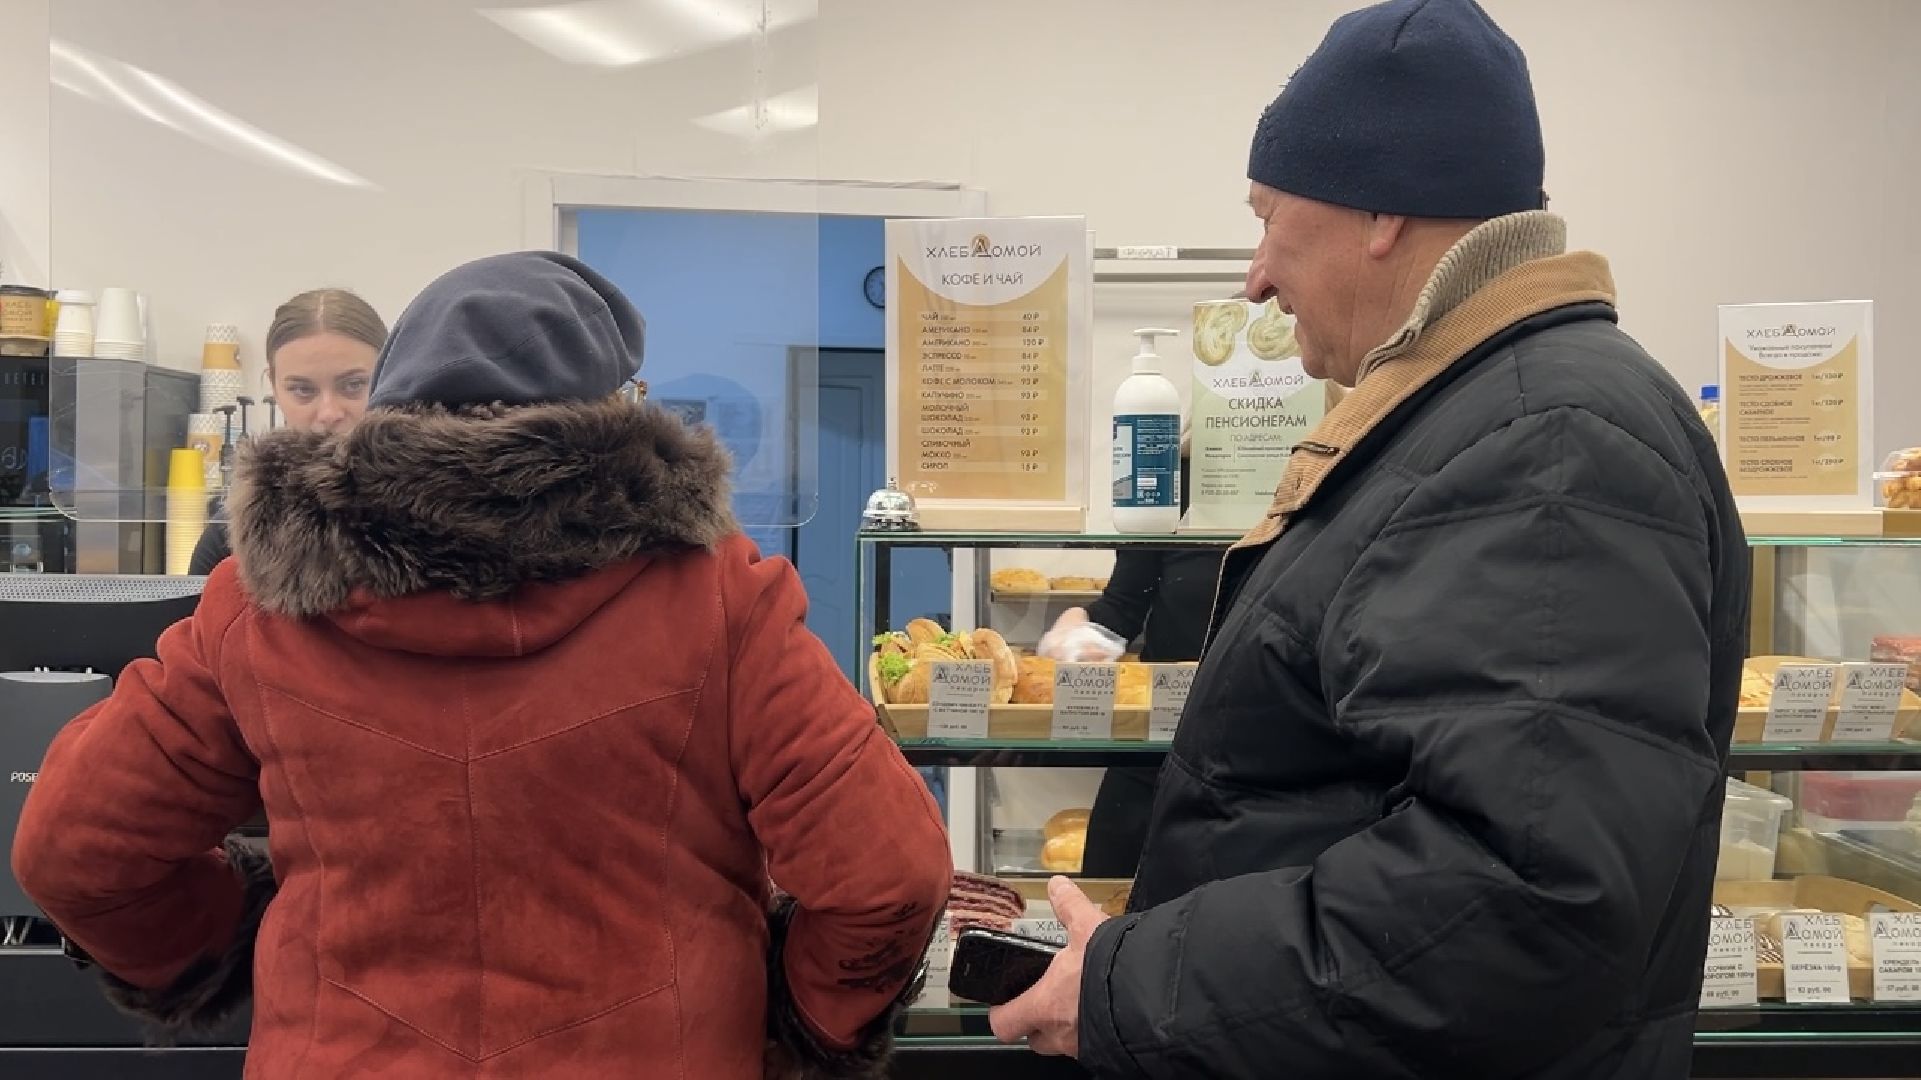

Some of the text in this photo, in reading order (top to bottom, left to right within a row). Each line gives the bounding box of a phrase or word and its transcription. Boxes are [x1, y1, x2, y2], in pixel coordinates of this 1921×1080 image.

[941, 271, 1024, 285] КОФЕ И ЧАЙ
[921, 311, 939, 320] ЧАЙ
[921, 326, 971, 334] АМЕРИКАНО
[921, 338, 971, 346] АМЕРИКАНО
[921, 352, 962, 360] ЭСПРЕССО
[921, 363, 944, 372] ЛАТТЕ
[921, 377, 943, 386] КОФЕ
[952, 377, 996, 385] МОЛОКОМ
[921, 403, 970, 412] МОЛОЧНЫЙ
[1228, 396, 1284, 412] СКИДКА
[921, 414, 964, 422] ШОКОЛАД
[1205, 414, 1307, 429] ПЕНСИОНЕРАМ
[921, 427, 964, 435] ШОКОЛАД
[921, 438, 971, 448] СЛИВОЧНЫЙ
[921, 450, 952, 458] МОККО
[921, 462, 949, 470] СИРОП
[956, 663, 991, 674] ХЛЕБ
[1080, 666, 1115, 677] ХЛЕБ
[1177, 669, 1195, 678] ХЛ
[1799, 669, 1833, 678] ХЛЕБ
[1870, 667, 1905, 678] ХЛЕБ
[933, 665, 991, 686] ДОМОЙ
[1057, 670, 1115, 688] ДОМОЙ
[1153, 672, 1192, 690] ДОМ
[1847, 671, 1904, 690] ДОМОЙ
[1775, 672, 1832, 691] ДОМОЙ
[1805, 914, 1841, 926] ХЛЕБ
[1894, 912, 1921, 925] ХЛЕ
[1035, 920, 1065, 931] ХЛЕ
[1713, 918, 1752, 931] ХЛЕБ
[1785, 920, 1842, 940] ДОМОЙ
[1874, 920, 1921, 939] ДОМО
[1709, 930, 1754, 945] ОМОЙ
[1791, 963, 1823, 971] БЕРЁЗКА
